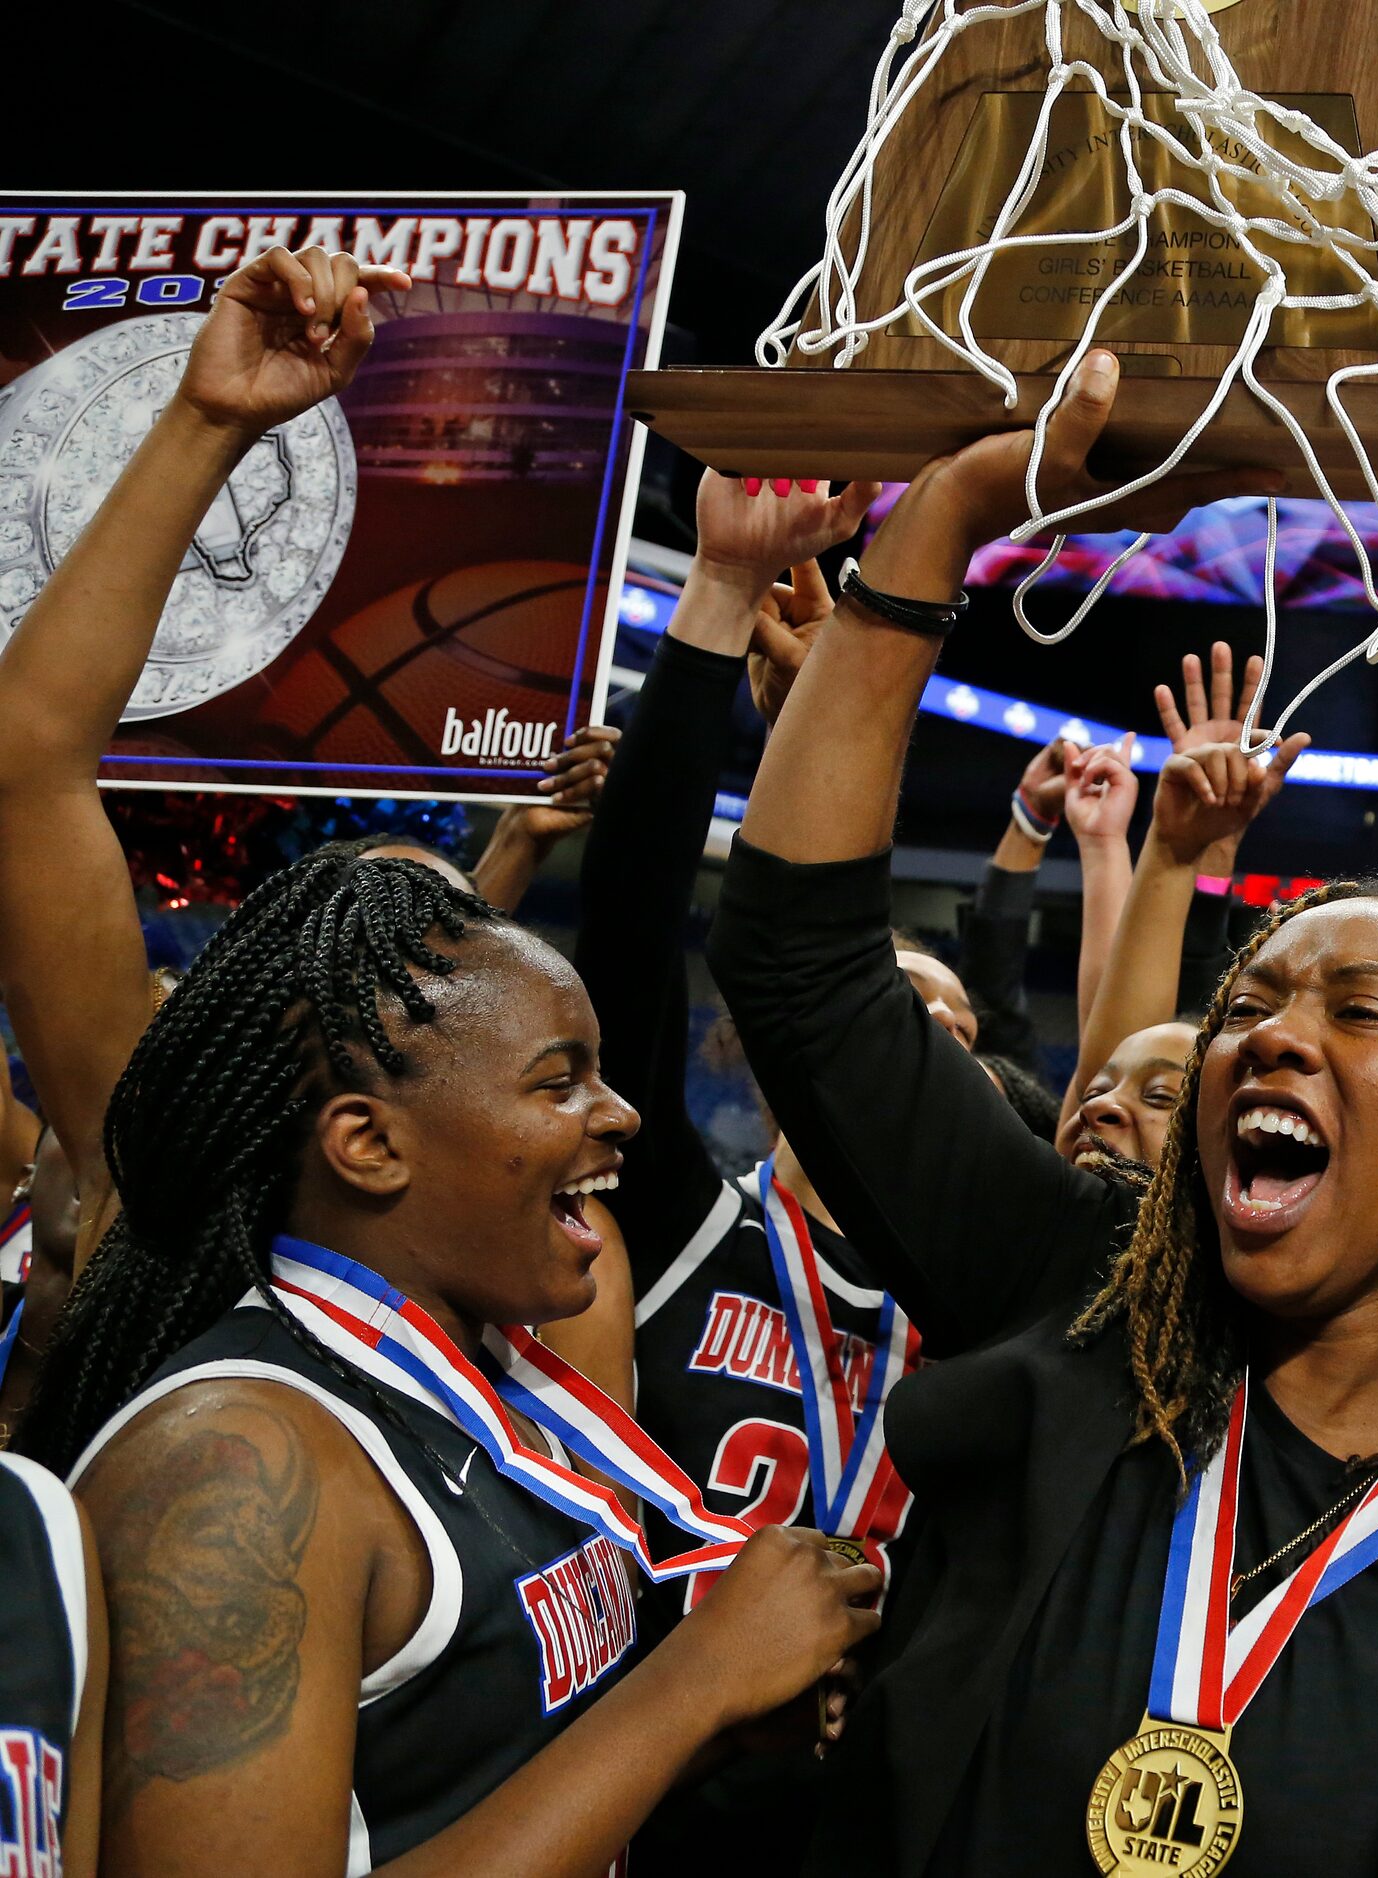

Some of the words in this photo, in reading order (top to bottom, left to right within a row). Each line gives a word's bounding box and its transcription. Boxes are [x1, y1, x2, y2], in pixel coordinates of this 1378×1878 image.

[1112, 258, 1251, 280] BSKETBALL
[1170, 289, 1256, 309] AAAAA
[441, 707, 558, 759] balfour
[1124, 1730, 1239, 1809] INTERSCHOLASTIC
[1088, 1767, 1117, 1874] UNIVERSITY
[1123, 1836, 1182, 1867] STATE
